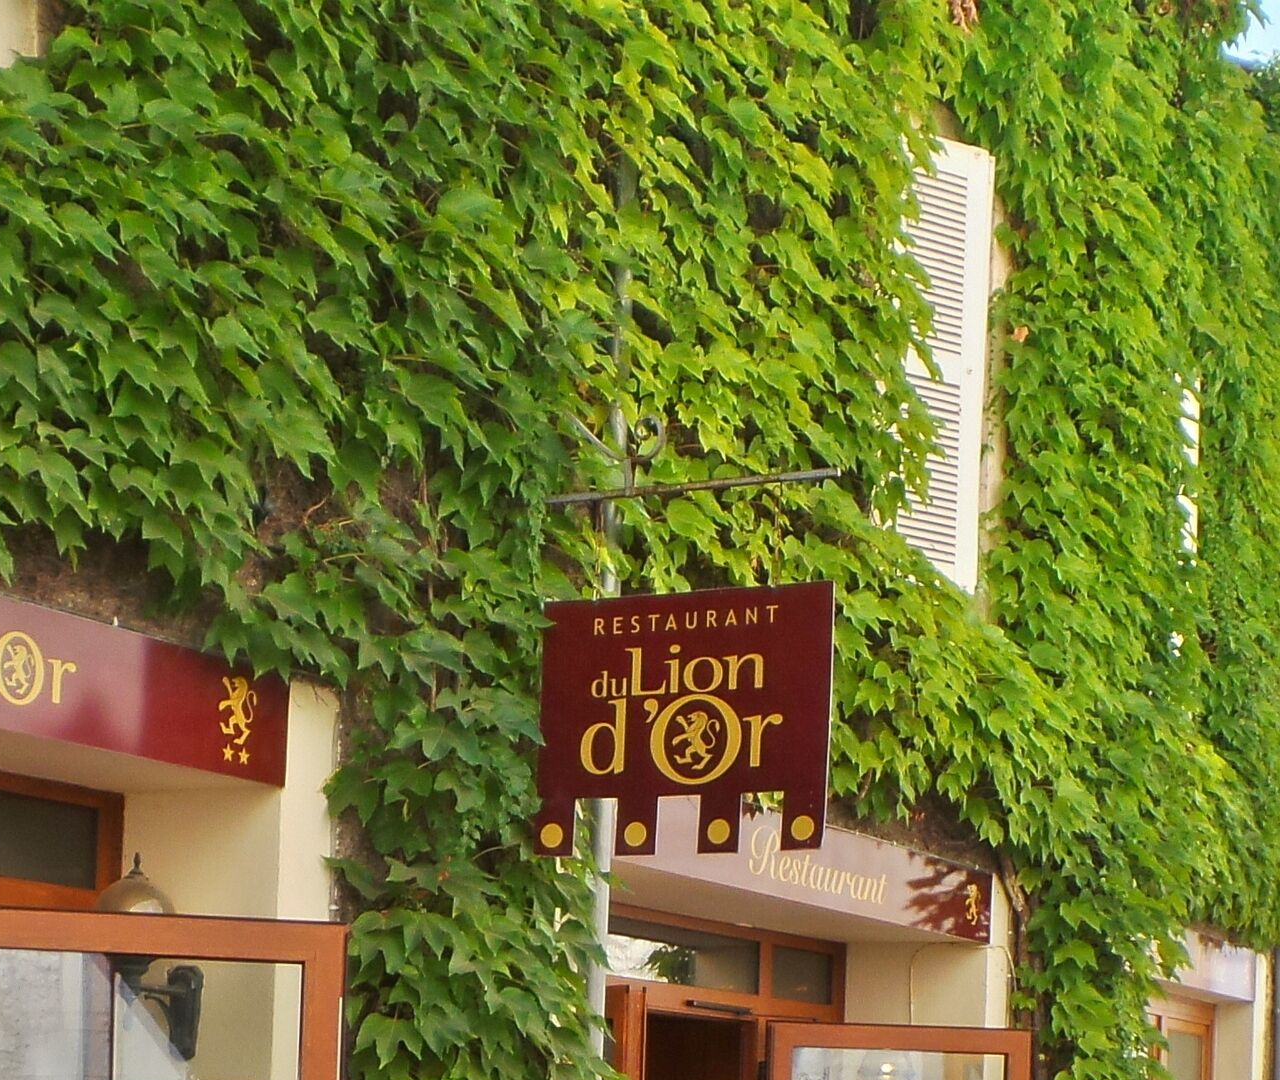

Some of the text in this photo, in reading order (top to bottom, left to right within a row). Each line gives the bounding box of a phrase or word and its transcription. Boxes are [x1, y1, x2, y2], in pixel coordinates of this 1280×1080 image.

[593, 605, 780, 636] RESTAURANT
[591, 644, 765, 698] du Lion
[580, 694, 784, 785] d'Or
[748, 825, 889, 905] Restaurant
